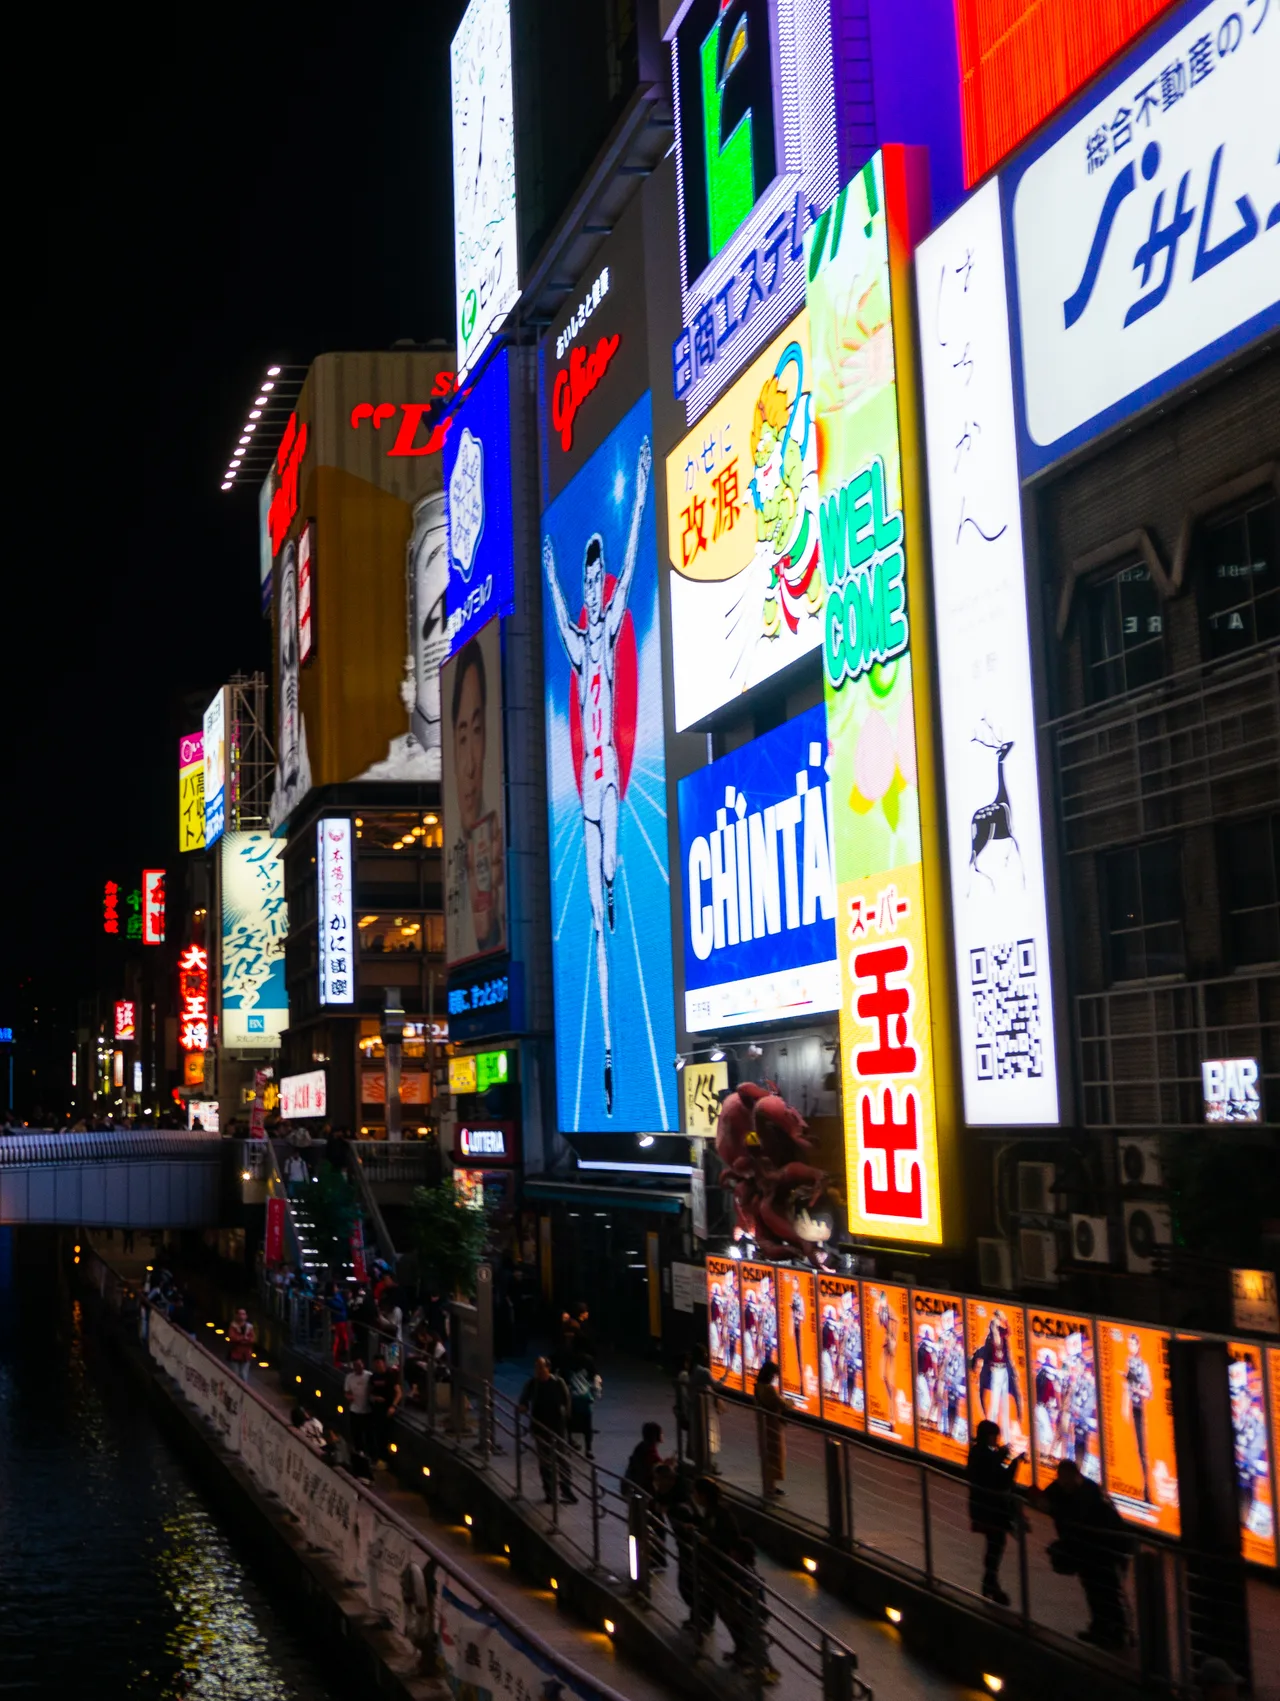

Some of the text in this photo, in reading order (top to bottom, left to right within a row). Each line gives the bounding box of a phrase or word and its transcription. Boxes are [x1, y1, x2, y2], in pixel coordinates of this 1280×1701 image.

[556, 266, 609, 359] おいしさと健康
[553, 334, 619, 452] Glico
[680, 455, 740, 568] 改源
[821, 455, 902, 588] WEL
[825, 549, 908, 688] COME
[589, 663, 604, 783] グリコ
[183, 775, 195, 847] バイト
[330, 913, 348, 997] かに道楽
[852, 888, 907, 935] スーパー
[854, 944, 922, 1219] 玉出
[1202, 1060, 1260, 1101] BAR
